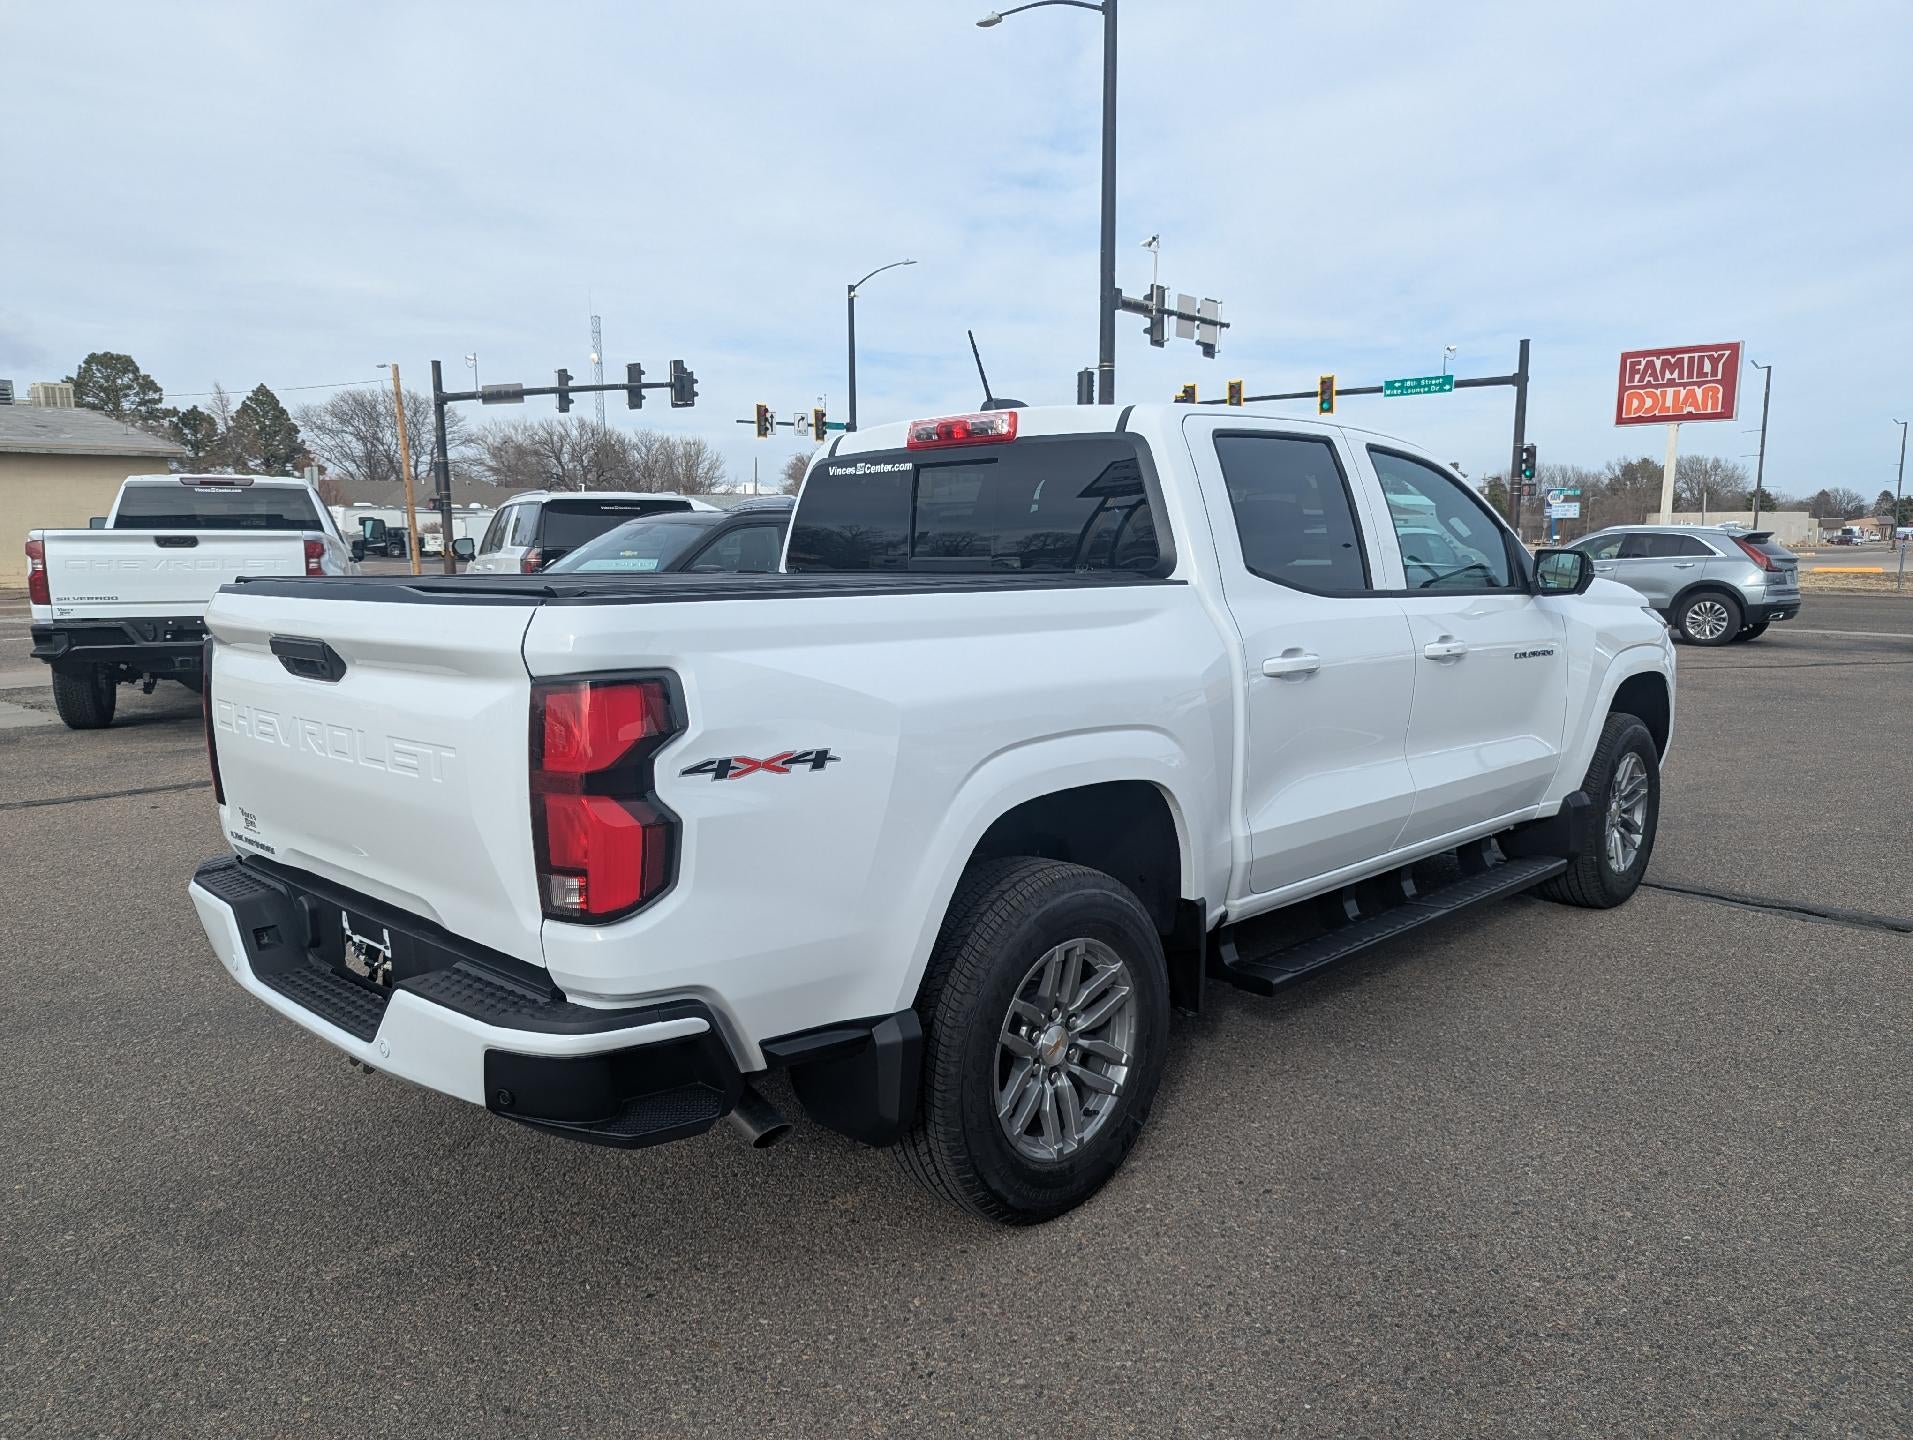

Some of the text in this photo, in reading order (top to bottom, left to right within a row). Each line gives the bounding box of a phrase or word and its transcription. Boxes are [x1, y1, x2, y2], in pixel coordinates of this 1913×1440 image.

[1625, 351, 1731, 386] FAMILY
[1420, 378, 1443, 386] Street
[1403, 387, 1429, 395] Lounge
[1622, 383, 1723, 418] DOLLAR
[64, 558, 289, 571] CHEVROLET
[1514, 649, 1554, 659] COLORADO
[214, 698, 457, 783] CHEVROLET
